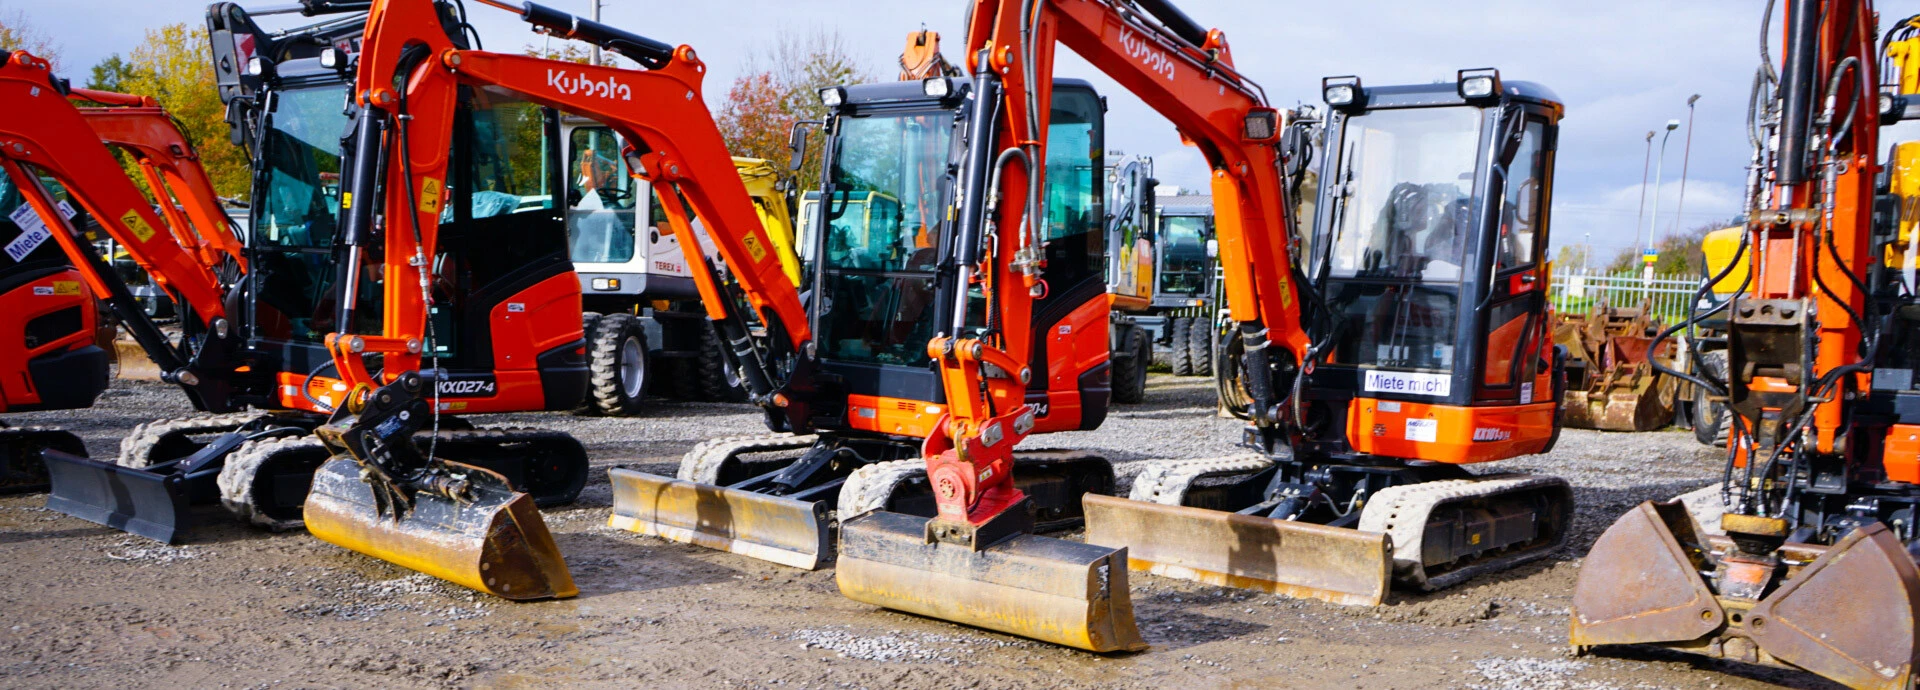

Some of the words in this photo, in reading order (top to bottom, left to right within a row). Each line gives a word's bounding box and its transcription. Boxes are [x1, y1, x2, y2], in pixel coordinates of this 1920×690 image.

[1118, 24, 1175, 81] Kubota
[547, 68, 632, 101] Kubota
[8, 231, 44, 259] Miete
[655, 261, 675, 272] TEREX
[438, 380, 495, 394] KX027-4
[1368, 374, 1404, 390] Miete
[1408, 377, 1448, 392] mich!
